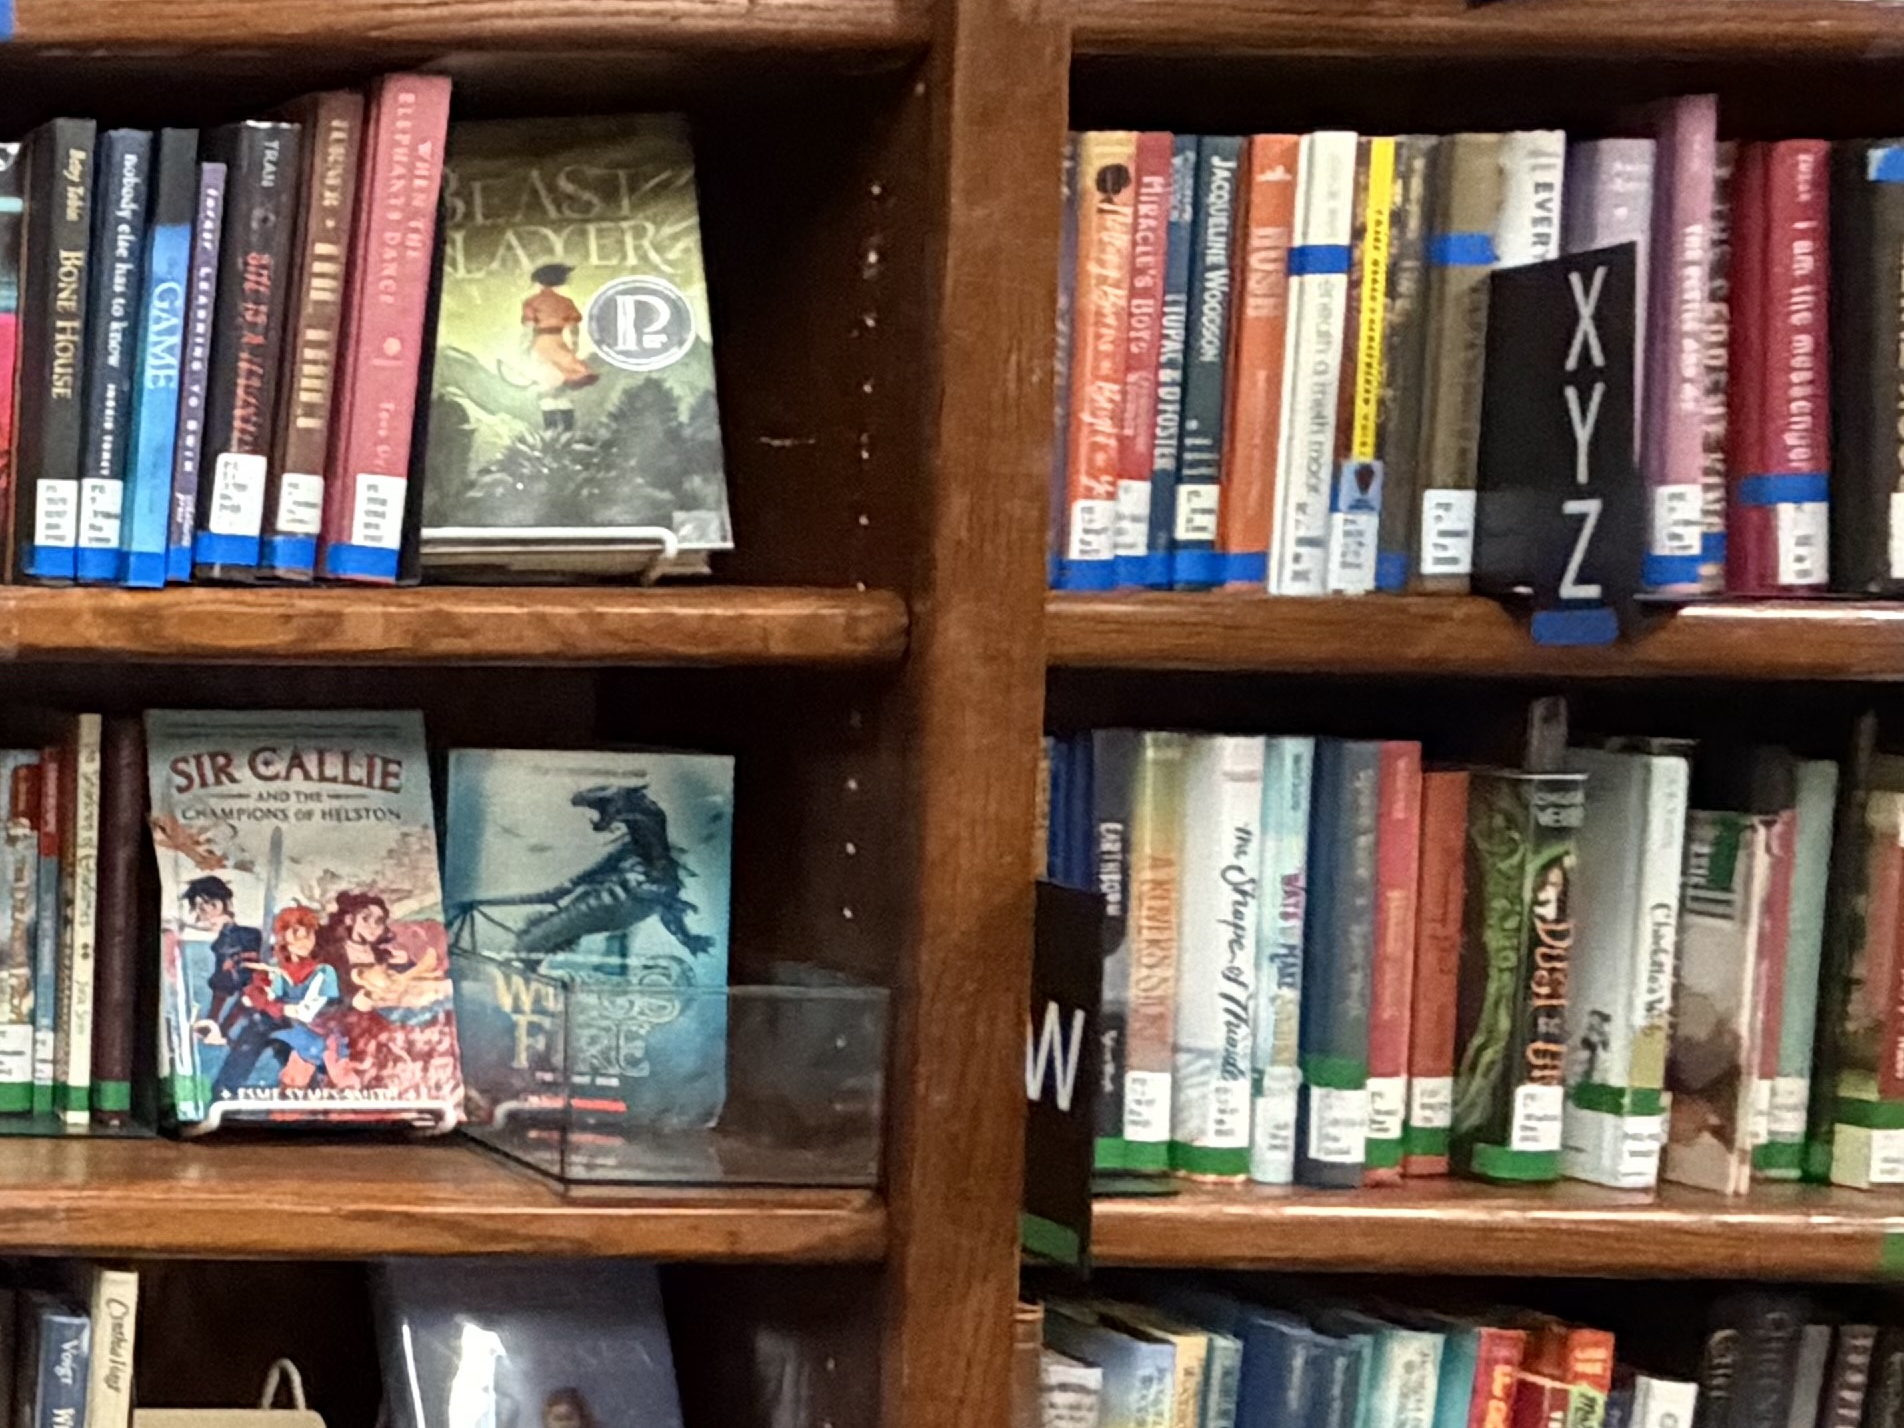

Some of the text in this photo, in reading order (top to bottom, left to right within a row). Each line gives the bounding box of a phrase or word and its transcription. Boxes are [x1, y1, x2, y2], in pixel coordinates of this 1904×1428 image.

[1201, 155, 1237, 361] JACQUELINE WOODSON
[51, 250, 84, 399] BONE HOUSE
[148, 281, 181, 390] GAME
[169, 745, 402, 794] SIR CALLIE
[181, 806, 401, 824] CHAMPIONS OF HELSTON
[255, 790, 324, 805] AND THE
[1024, 1001, 1086, 1112] W
